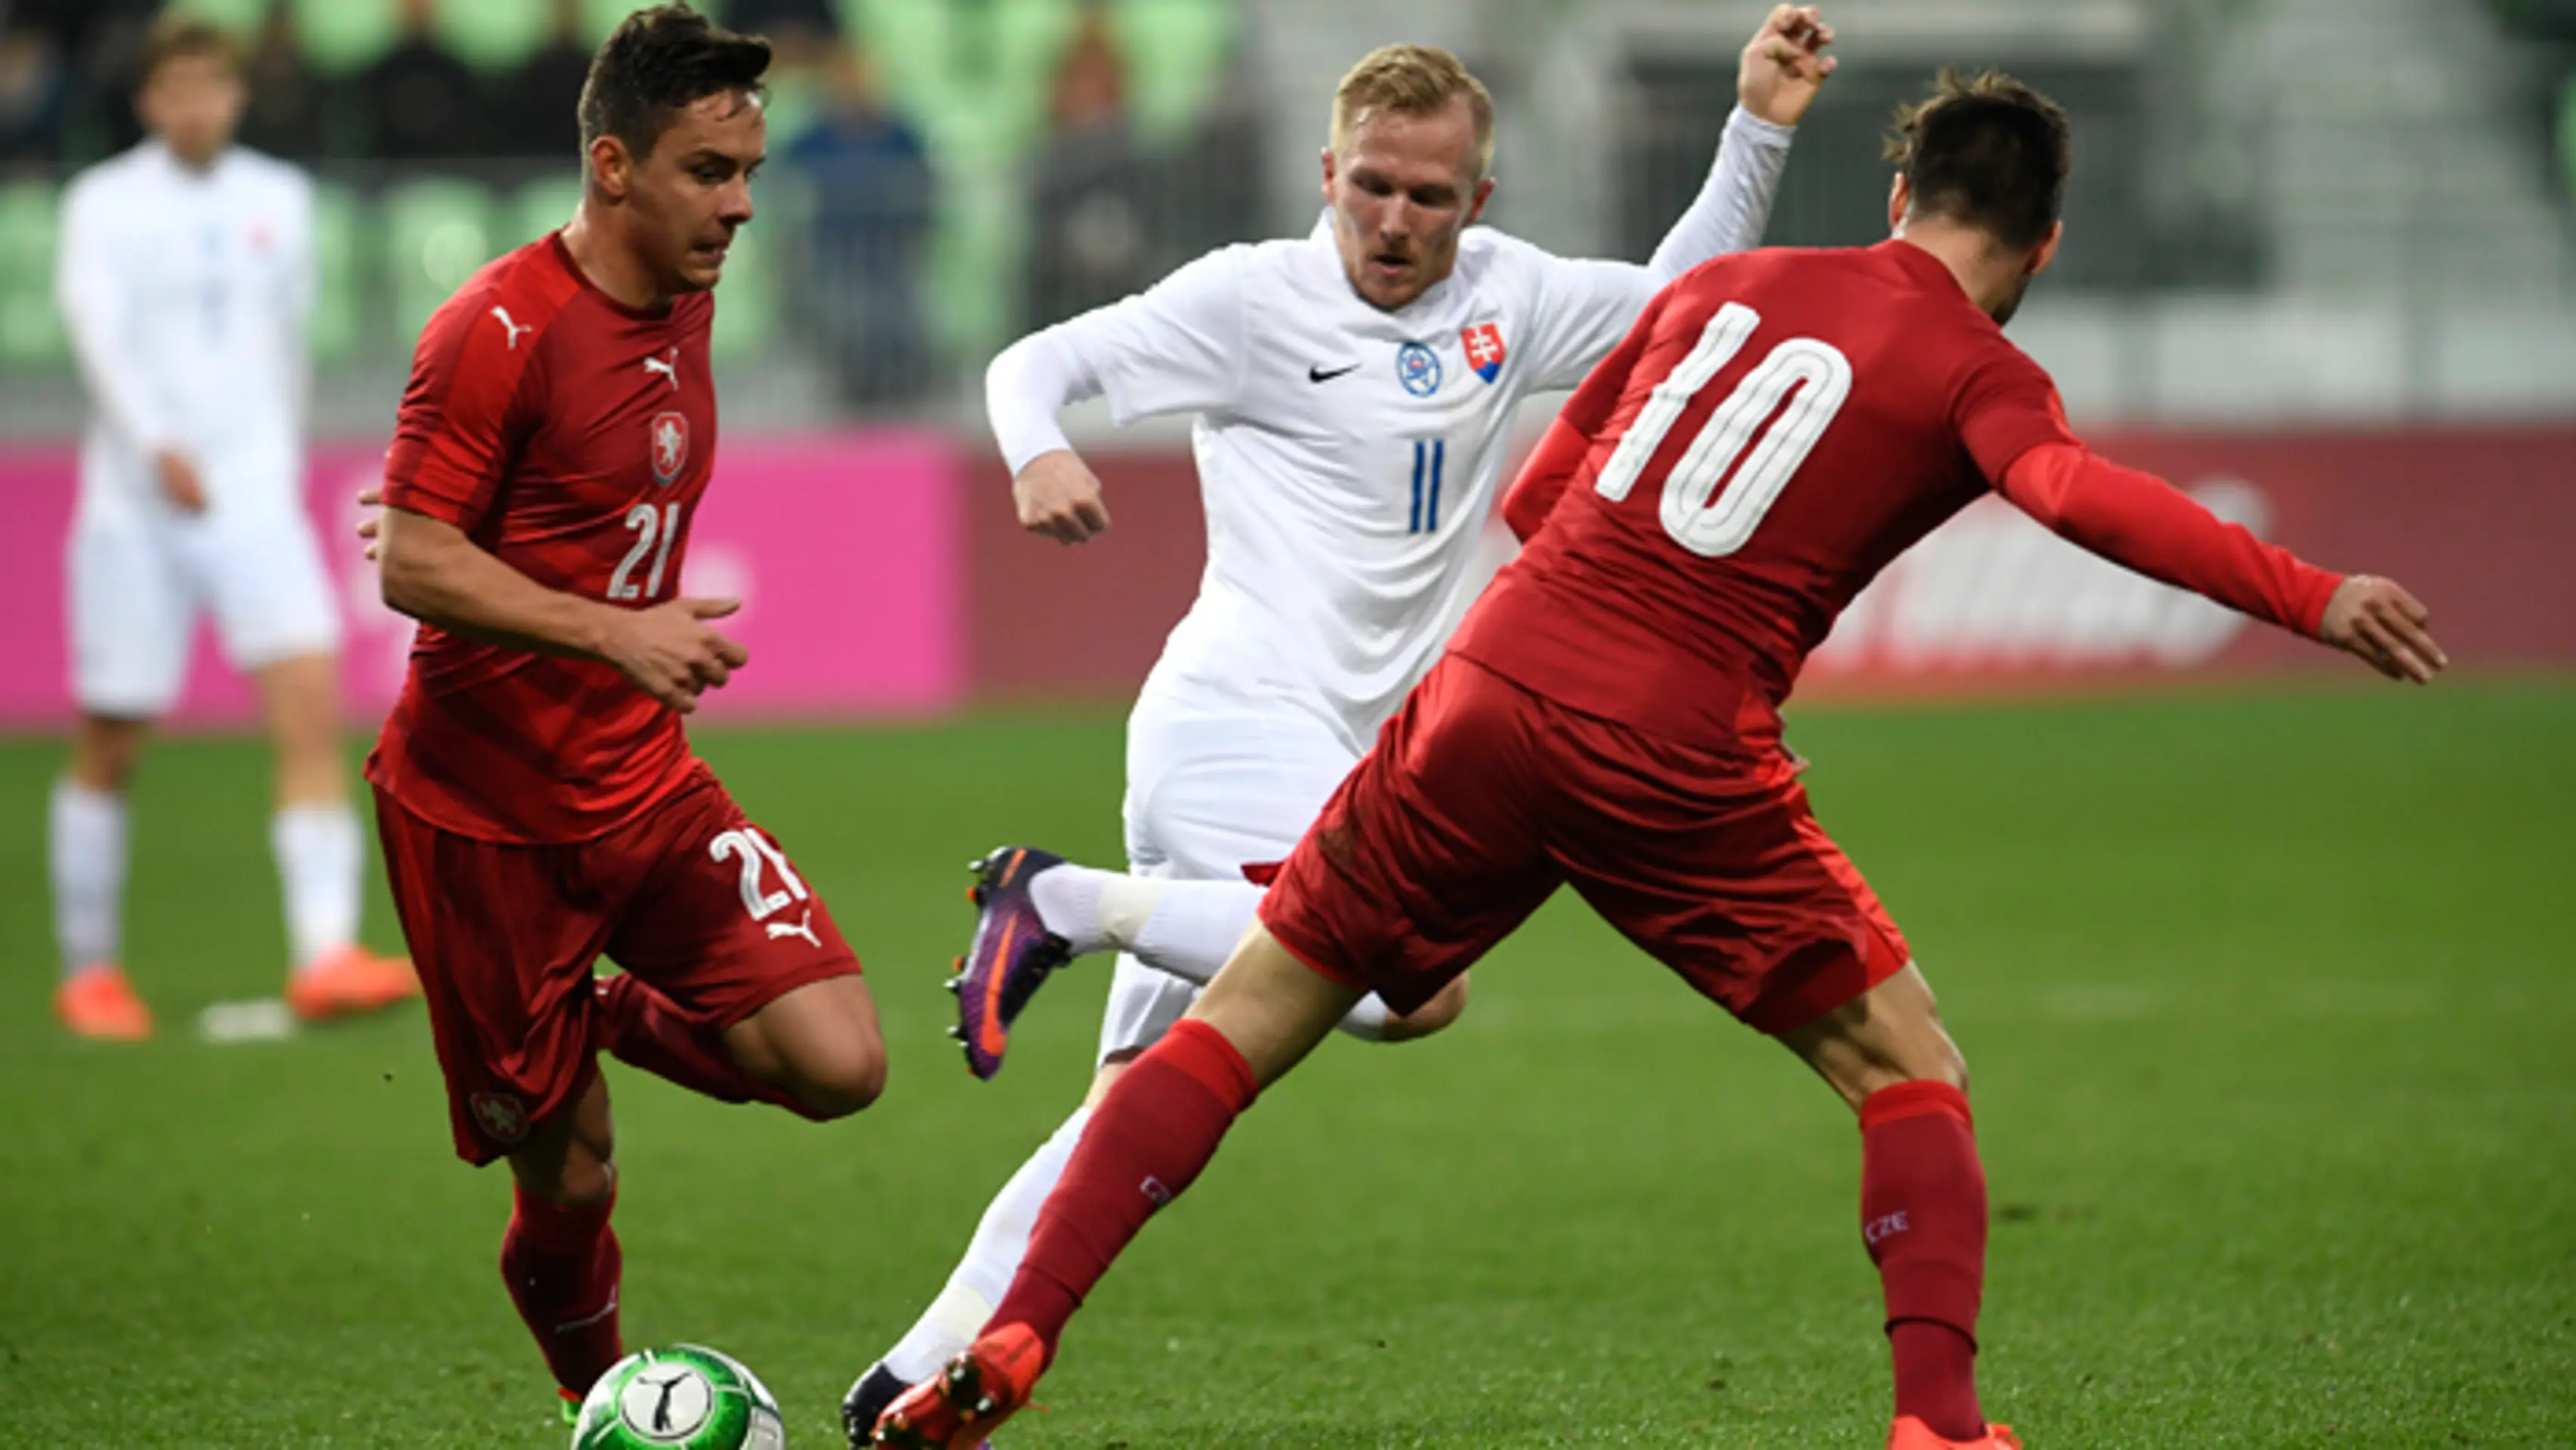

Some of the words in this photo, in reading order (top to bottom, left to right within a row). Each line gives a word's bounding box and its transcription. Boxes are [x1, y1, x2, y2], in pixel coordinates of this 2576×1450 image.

[1594, 301, 1853, 558] 10
[1409, 439, 1444, 535] 11
[606, 501, 680, 599] 21
[709, 827, 808, 921] 21
[1864, 1210, 1910, 1245] CZE
